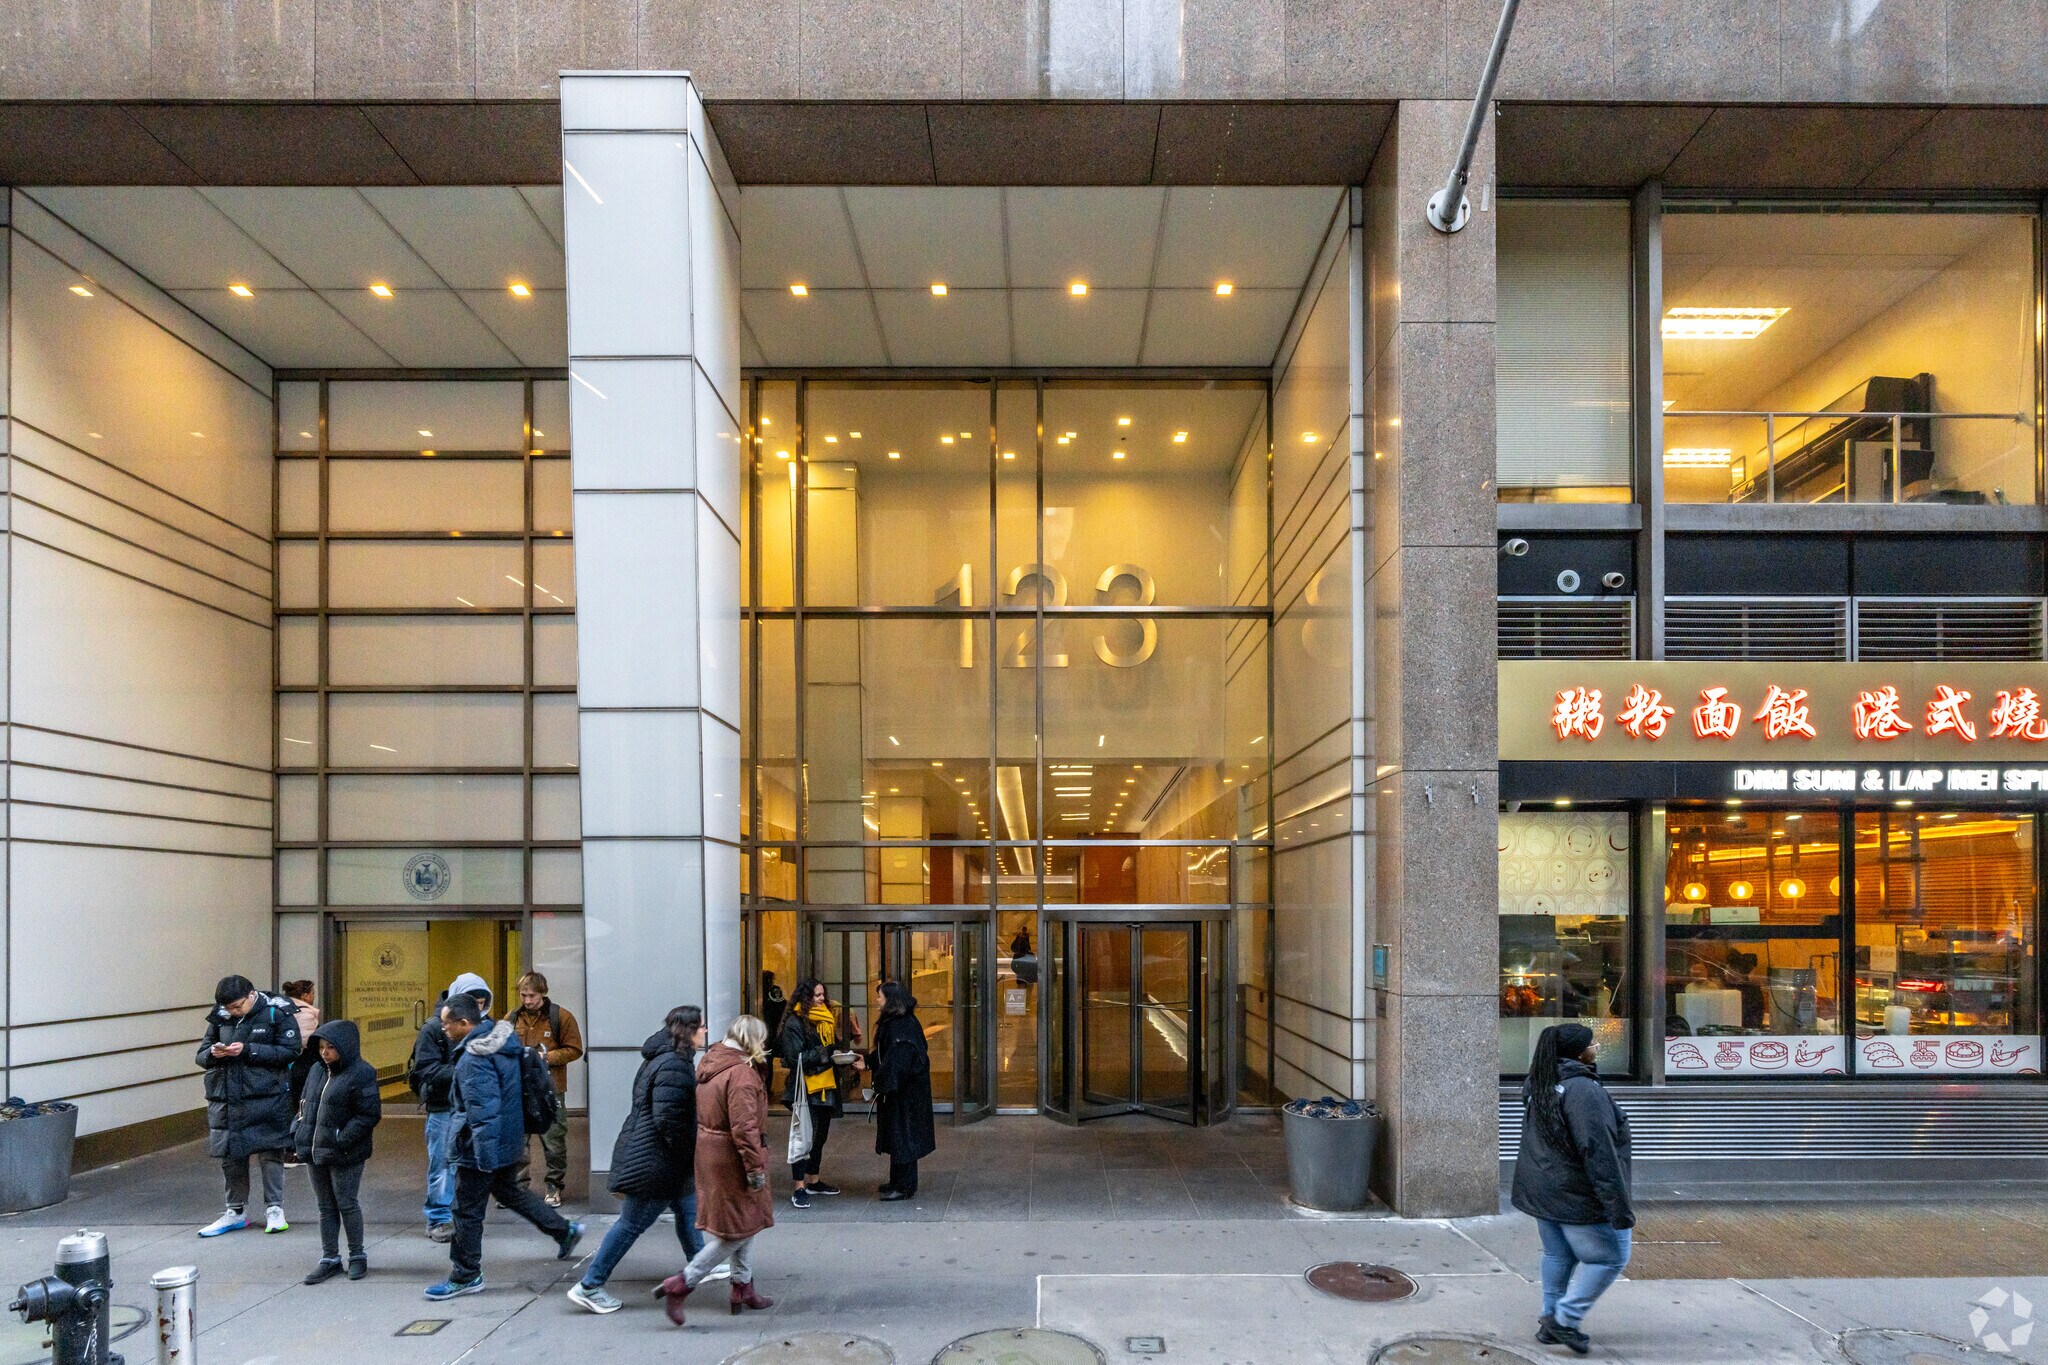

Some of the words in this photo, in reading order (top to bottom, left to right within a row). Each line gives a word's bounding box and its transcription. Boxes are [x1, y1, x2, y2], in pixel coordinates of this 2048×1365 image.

[934, 563, 1158, 669] 123
[1853, 685, 2048, 742] 港式燒
[1734, 769, 1788, 790] DIM
[1793, 769, 1856, 790] SUM
[1860, 769, 1884, 790] &
[1889, 769, 1943, 790] LAP
[1947, 769, 1998, 790] MEI
